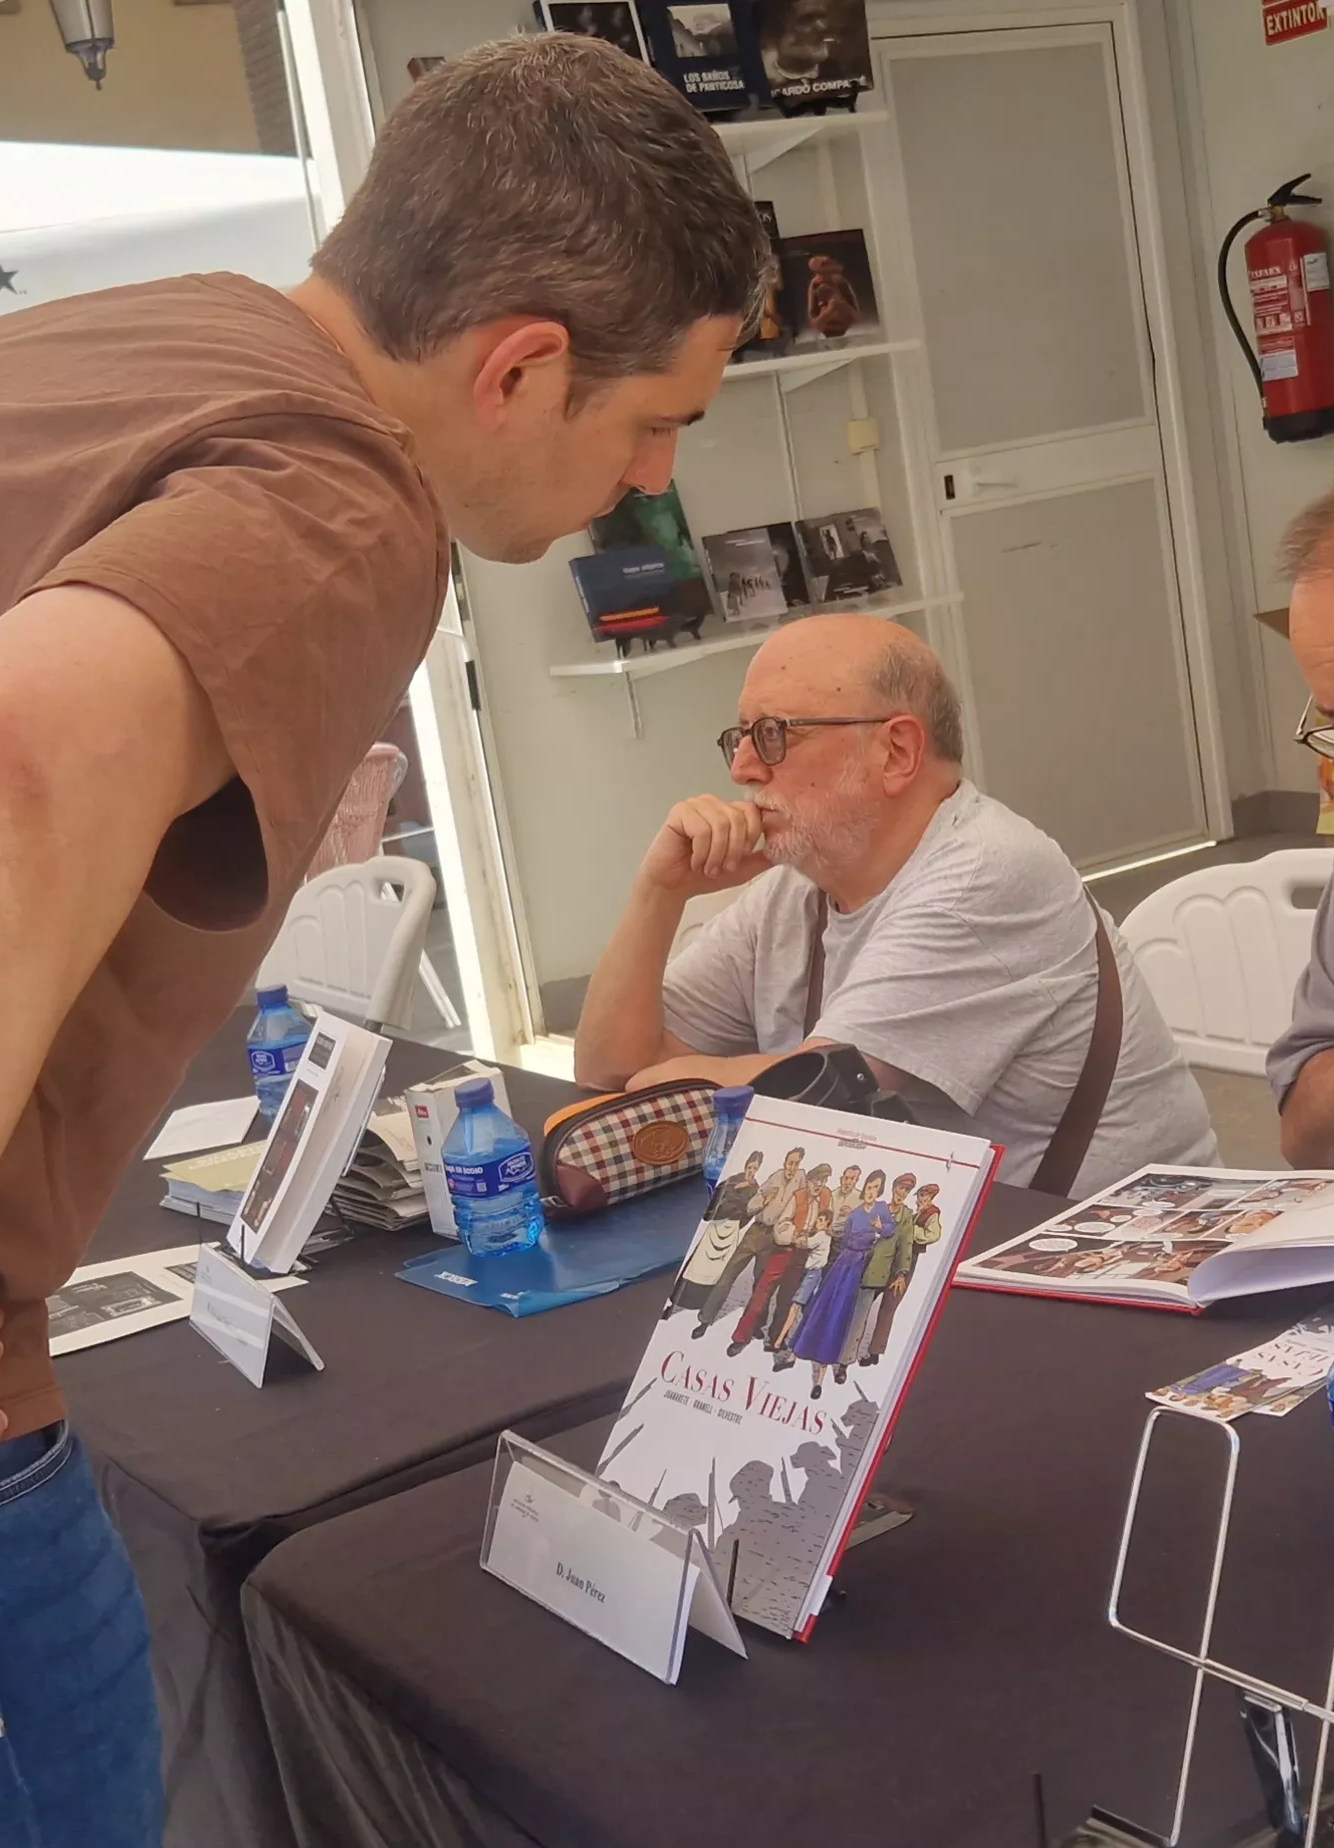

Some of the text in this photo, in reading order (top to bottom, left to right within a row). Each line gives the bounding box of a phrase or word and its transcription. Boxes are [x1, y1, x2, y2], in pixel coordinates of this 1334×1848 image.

[683, 72, 701, 84] LOS
[685, 82, 699, 94] DE
[660, 1349, 828, 1436] CASAS VIEJAS
[556, 1561, 607, 1605] D. Juan Pérez
